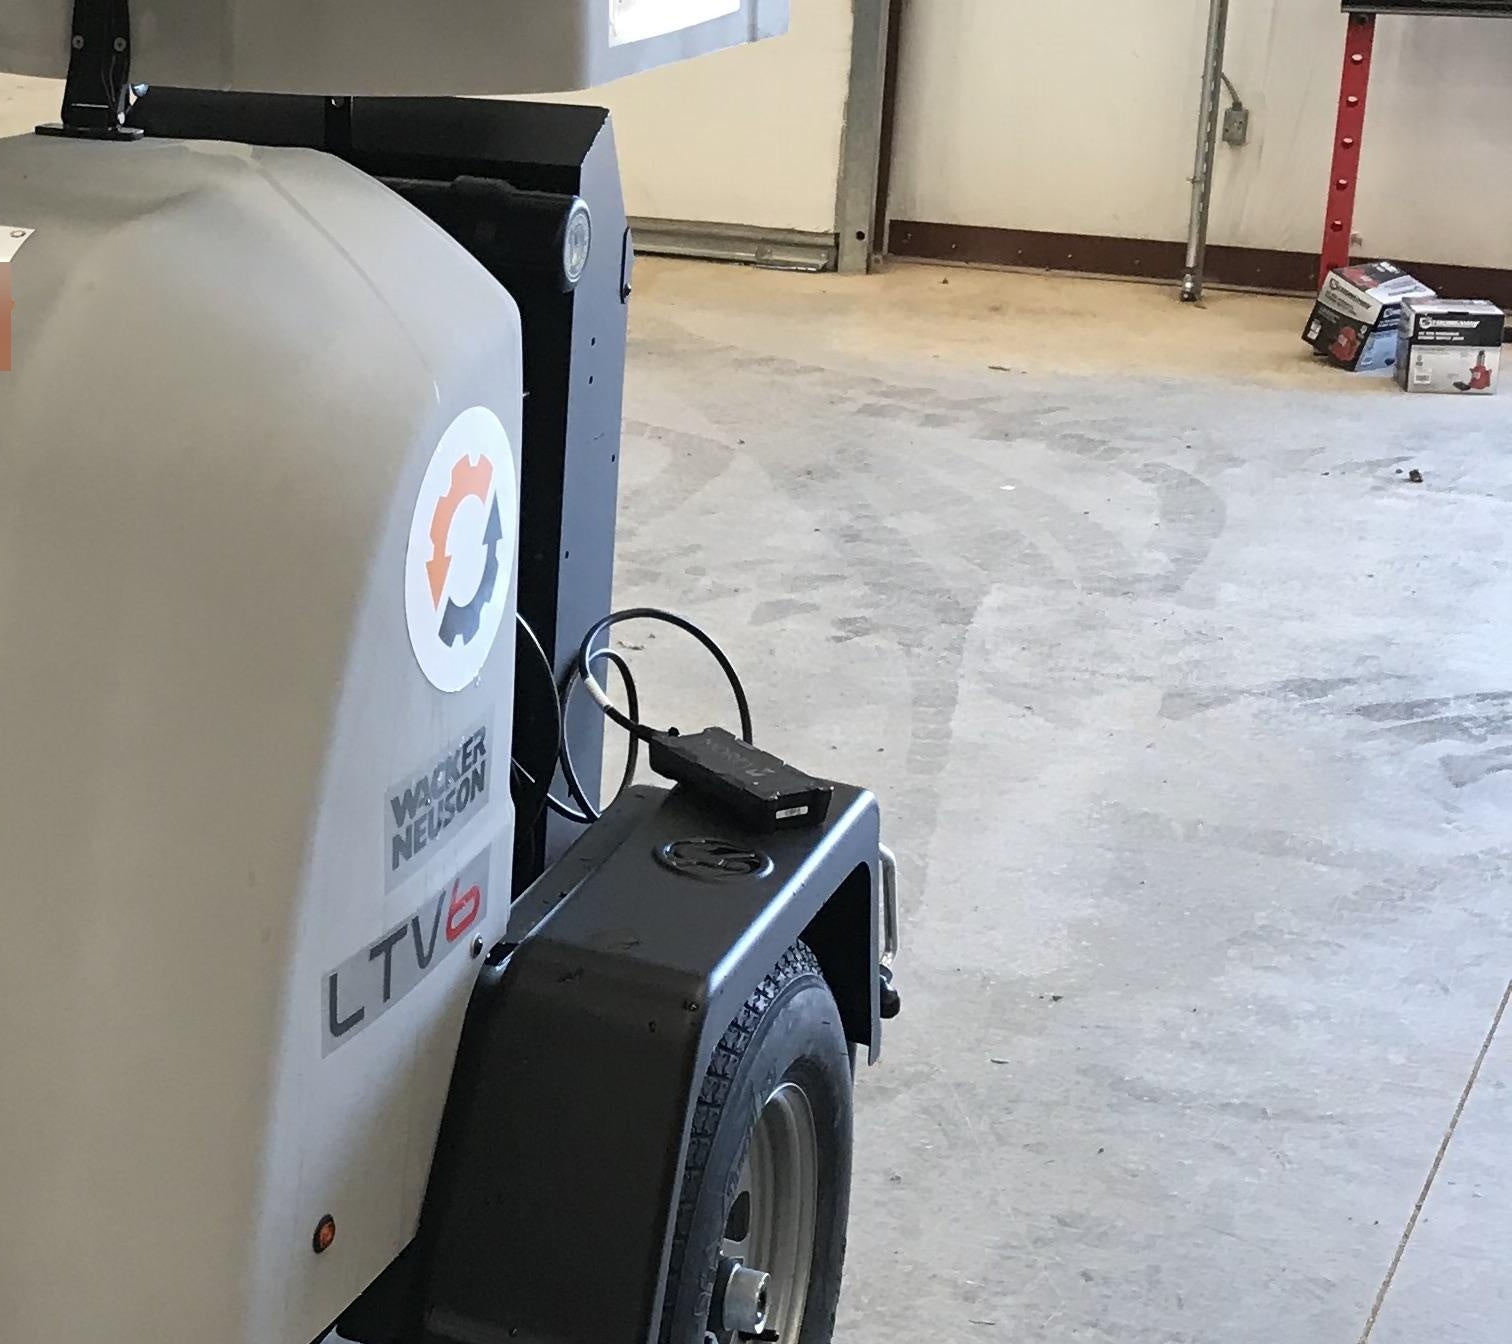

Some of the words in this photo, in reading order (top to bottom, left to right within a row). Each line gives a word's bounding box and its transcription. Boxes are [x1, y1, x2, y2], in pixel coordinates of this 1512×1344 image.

[390, 725, 487, 829] WACKER
[391, 759, 487, 872] NEUSON
[329, 877, 481, 1038] LTV6
